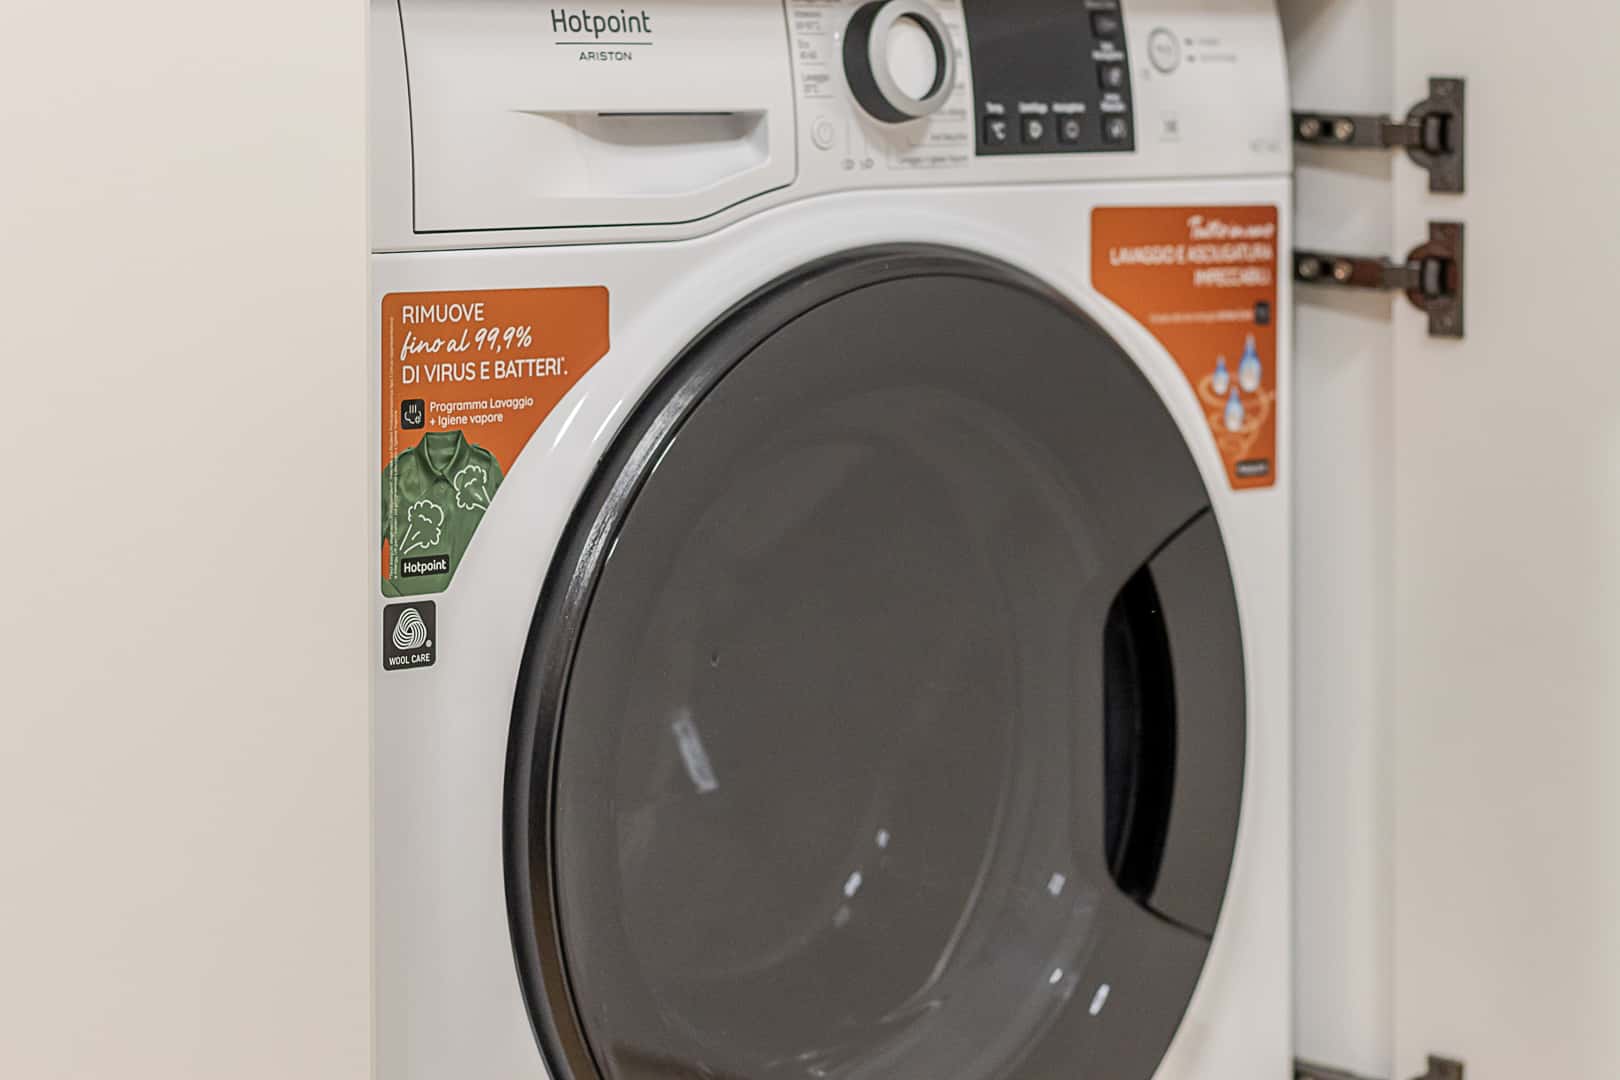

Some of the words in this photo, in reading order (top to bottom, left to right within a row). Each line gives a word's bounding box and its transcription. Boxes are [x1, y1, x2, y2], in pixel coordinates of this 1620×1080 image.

[551, 9, 652, 38] Hotpoint
[579, 51, 632, 61] ARISTON
[402, 303, 485, 324] RIMUOVE
[400, 331, 445, 361] fino
[447, 329, 471, 352] al
[474, 326, 532, 353] 99,9%
[402, 364, 420, 384] DI
[424, 361, 476, 382] VIRUS
[480, 361, 490, 380] E
[429, 400, 488, 414] Programma
[489, 396, 534, 410] Lavaggio
[438, 415, 468, 428] Igiene
[469, 413, 504, 426] vapore
[403, 559, 447, 575] Hotpoint
[389, 656, 410, 666] WOOL
[411, 653, 431, 663] CARE
